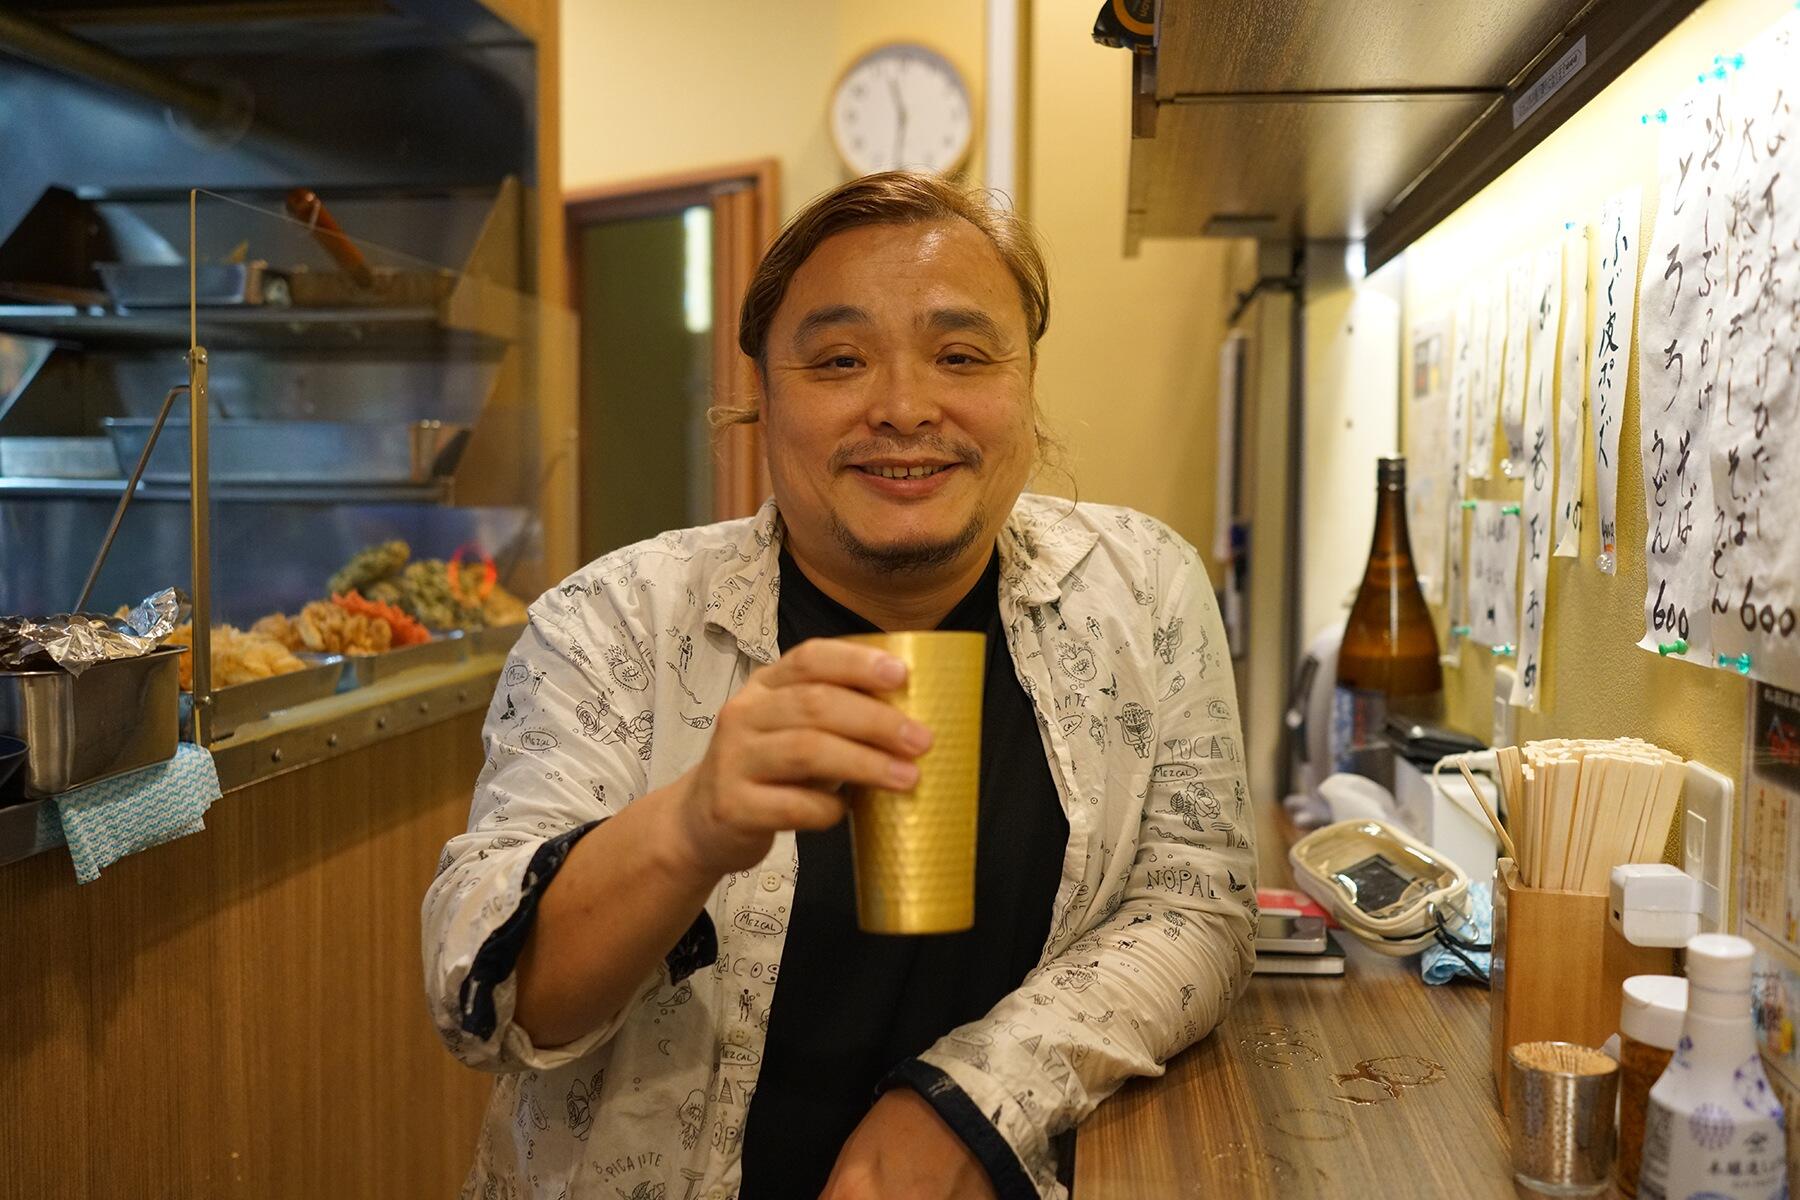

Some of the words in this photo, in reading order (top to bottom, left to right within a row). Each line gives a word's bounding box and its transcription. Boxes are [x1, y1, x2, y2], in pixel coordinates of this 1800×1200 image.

[1663, 152, 1694, 413] とろろ
[1652, 429, 1676, 553] うどん
[1677, 429, 1697, 544] そば
[1728, 445, 1753, 546] そば
[1711, 506, 1732, 615] うどん
[1653, 579, 1690, 641] 600
[1740, 577, 1796, 638] 600
[1153, 766, 1193, 777] MEZCAL
[1145, 869, 1222, 900] NOPAL
[739, 912, 776, 932] MEZCAL
[605, 1151, 663, 1178] PICANTE
